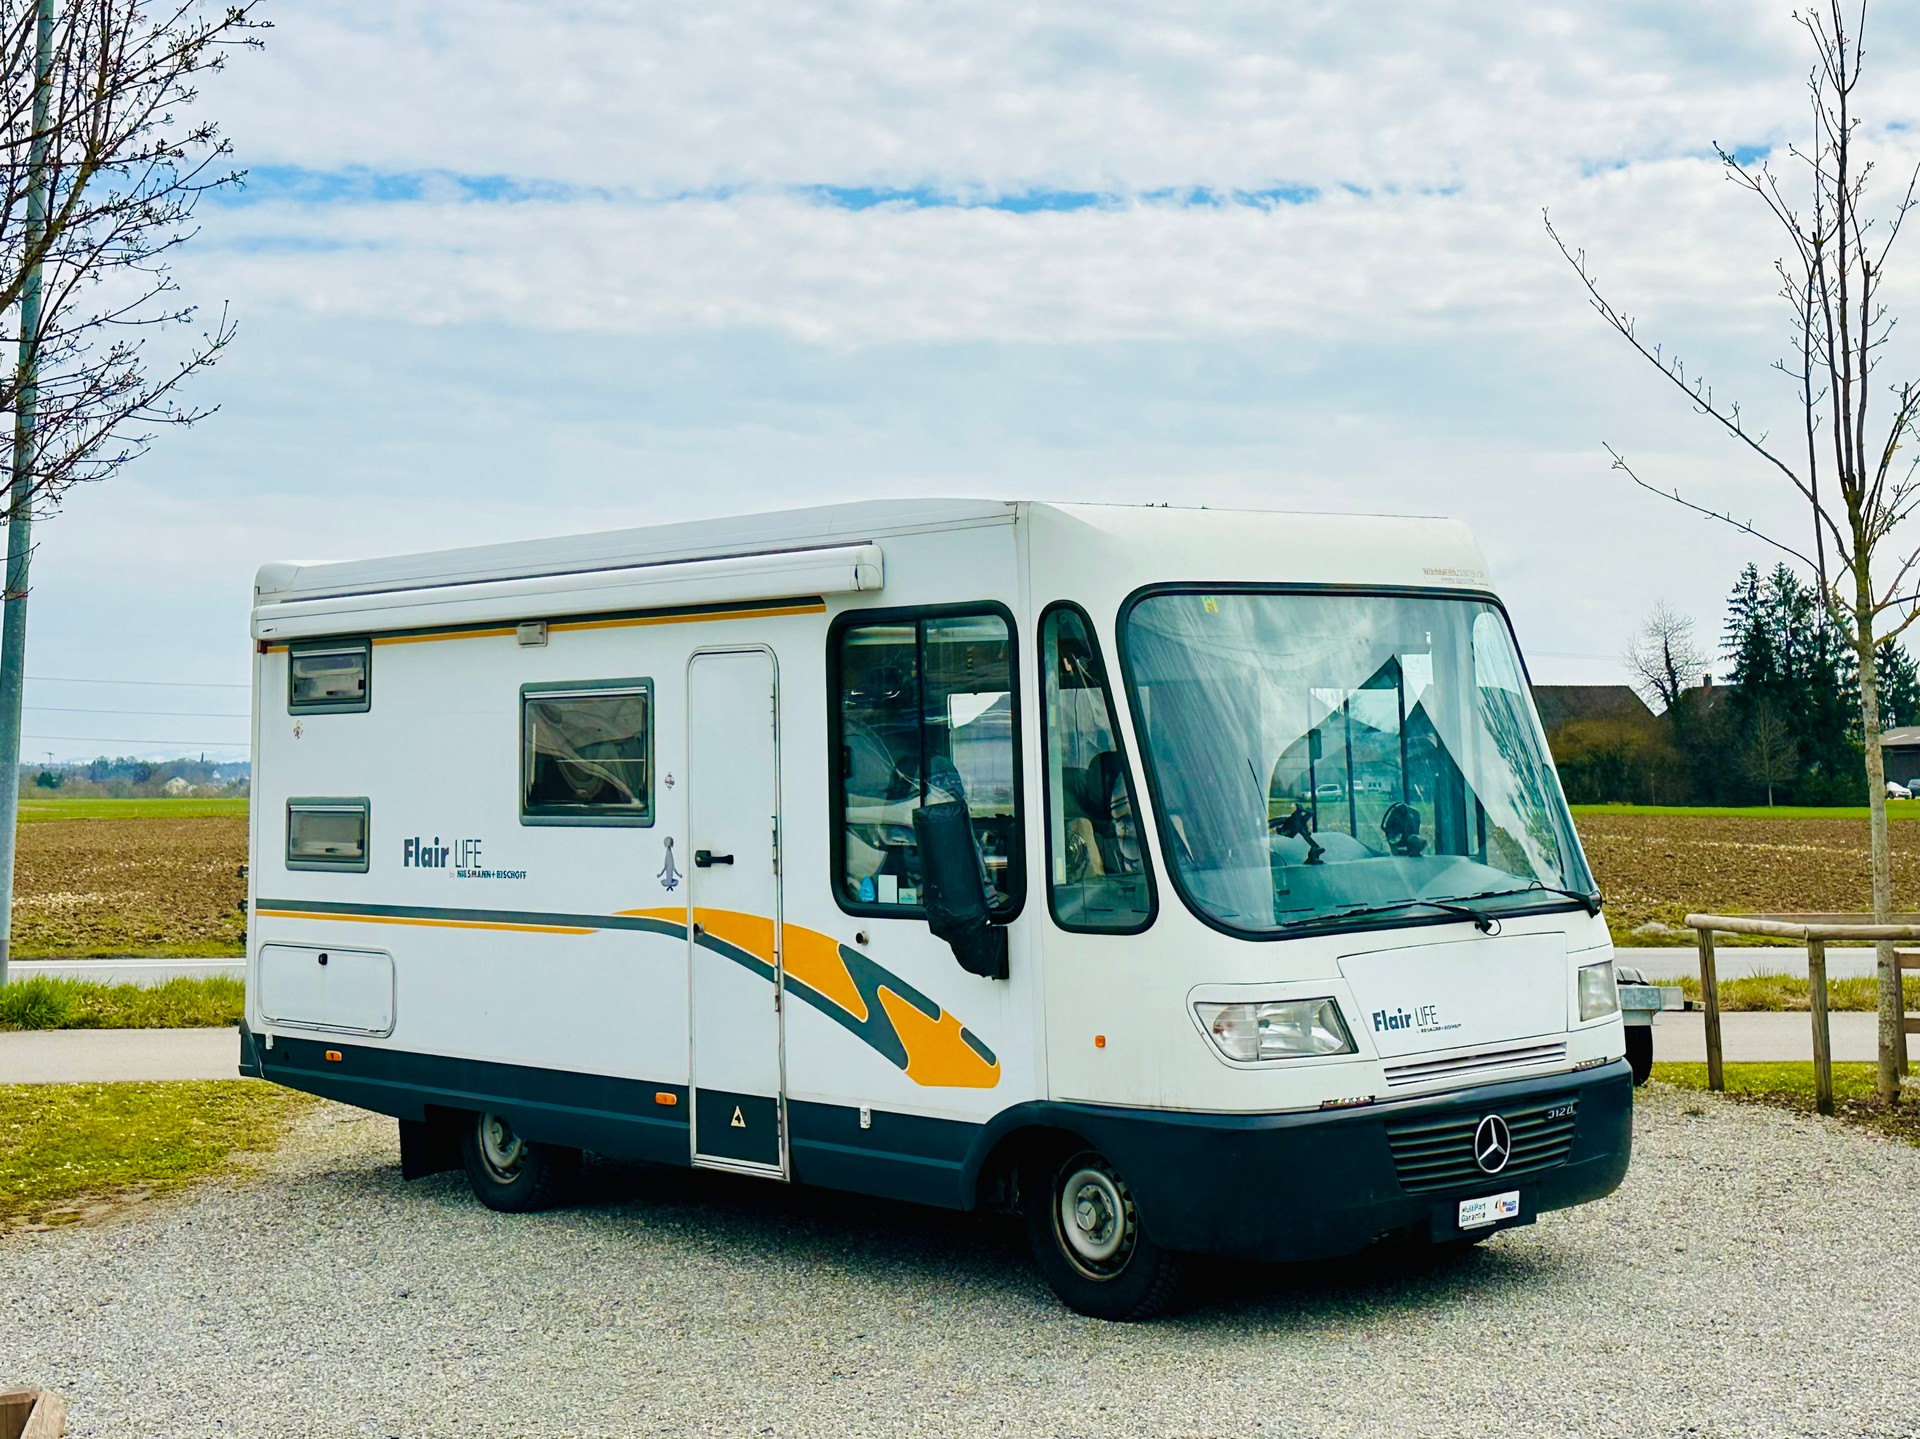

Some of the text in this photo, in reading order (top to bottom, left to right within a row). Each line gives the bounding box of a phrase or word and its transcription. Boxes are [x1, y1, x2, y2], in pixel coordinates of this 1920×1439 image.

[403, 836, 482, 868] Flair LIFE
[1372, 1007, 1412, 1032] Flair
[1414, 1005, 1439, 1027] LIFE
